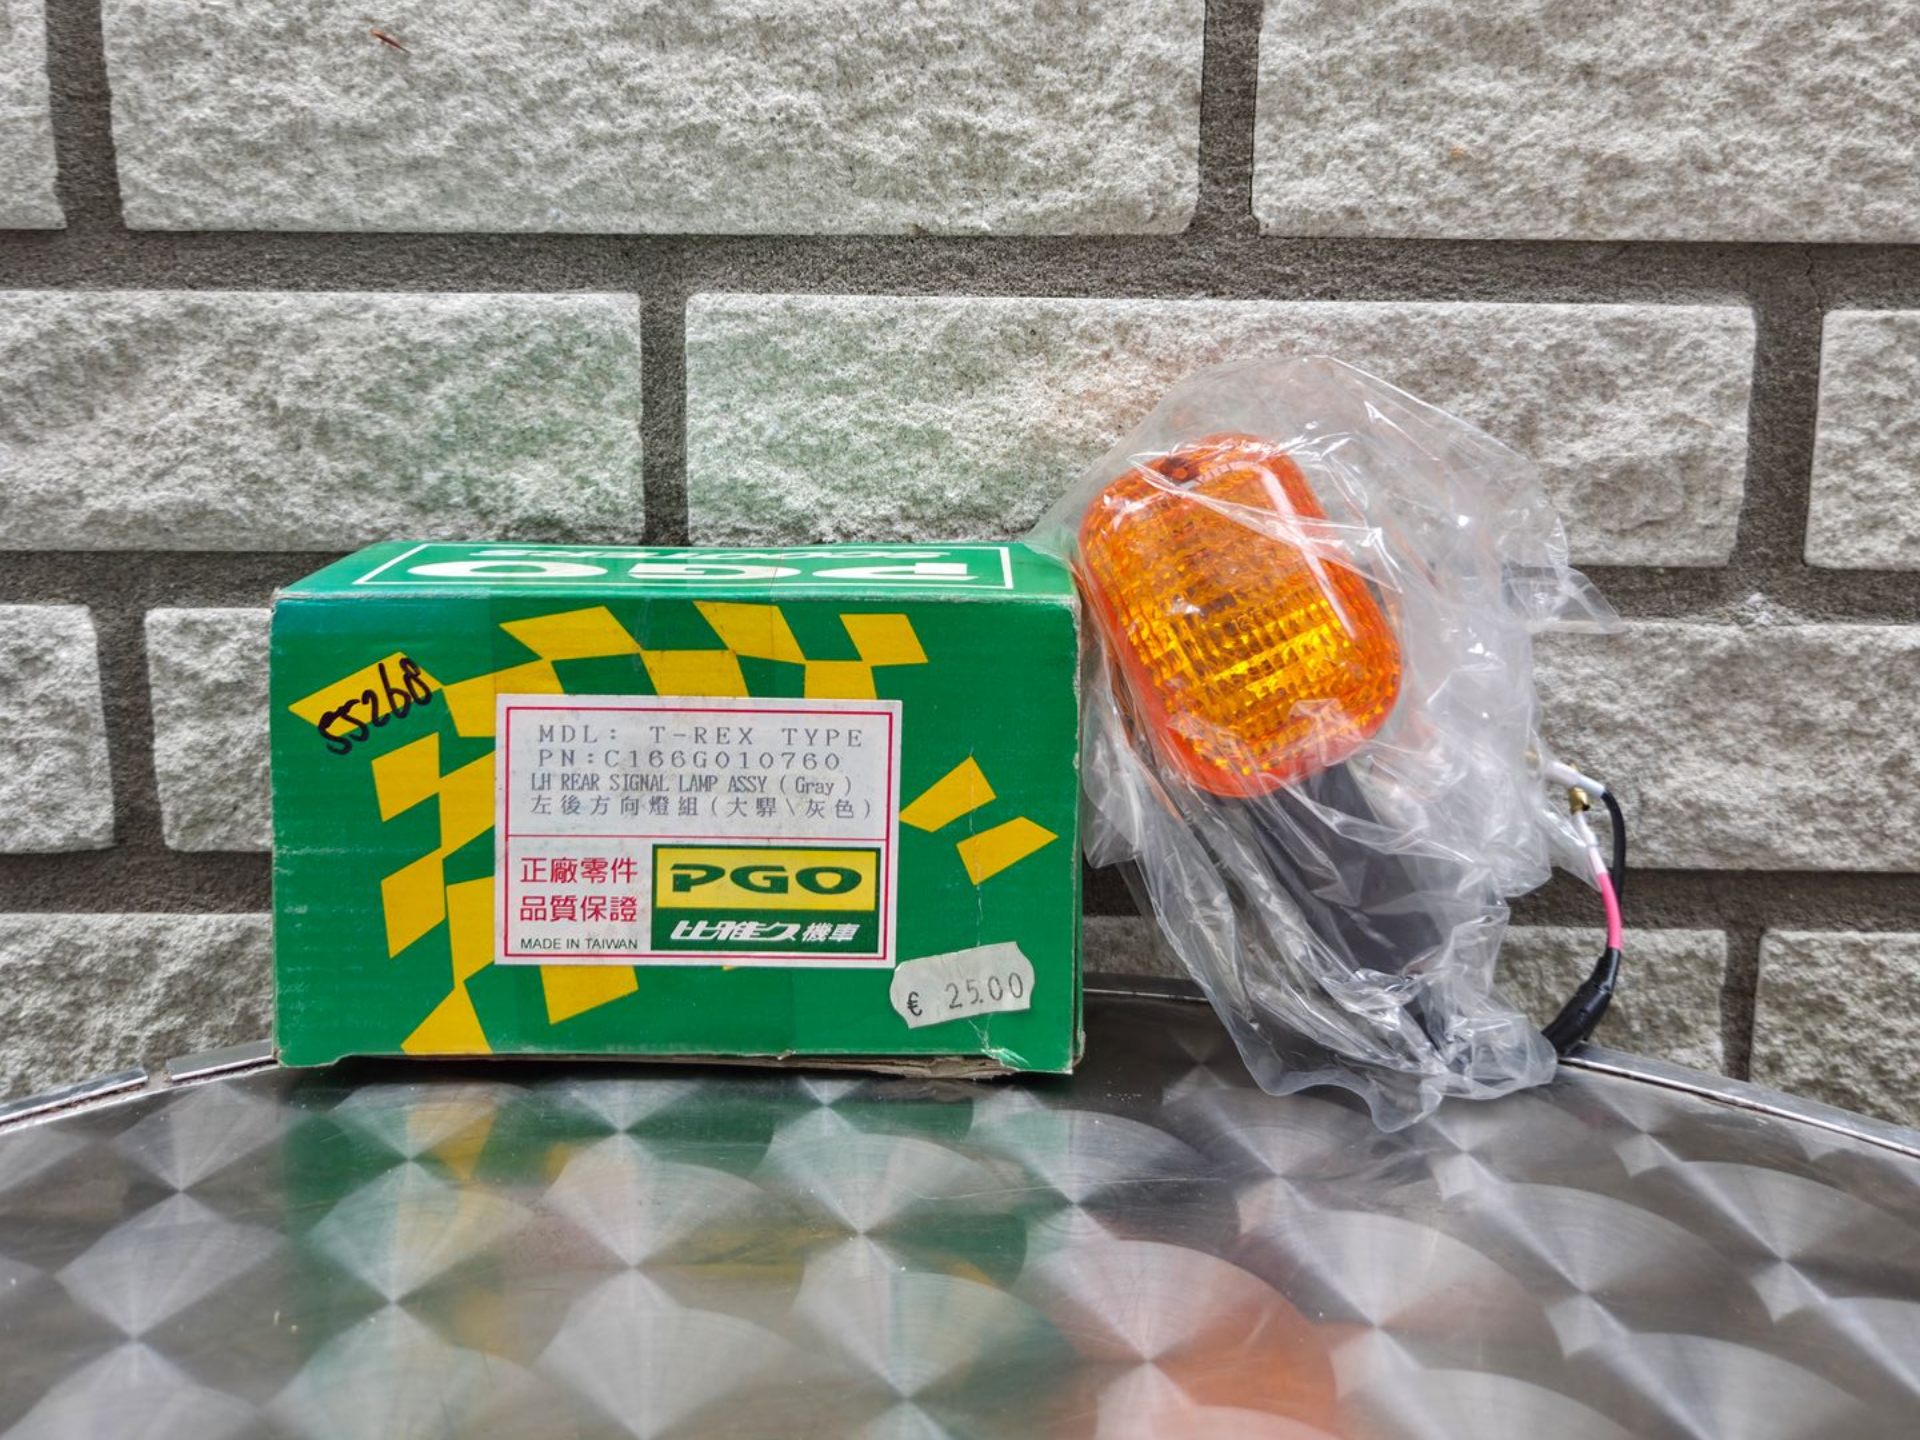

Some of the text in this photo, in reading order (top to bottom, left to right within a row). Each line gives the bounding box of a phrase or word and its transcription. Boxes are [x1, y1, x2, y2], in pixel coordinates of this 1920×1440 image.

[407, 560, 979, 581] PGO
[538, 724, 864, 748] MDL: T-REX TYPE
[530, 773, 552, 792] LH
[561, 774, 600, 792] REAR
[609, 774, 669, 792] SIGNAL
[678, 775, 718, 793] LAMP
[728, 775, 767, 793] ASSY
[520, 857, 639, 885] 正廠零件
[670, 863, 863, 895] PGO
[520, 895, 638, 923] 品質保證
[520, 938, 638, 951] MADE IN TAIWAN
[907, 972, 1024, 1017] € 25.00
